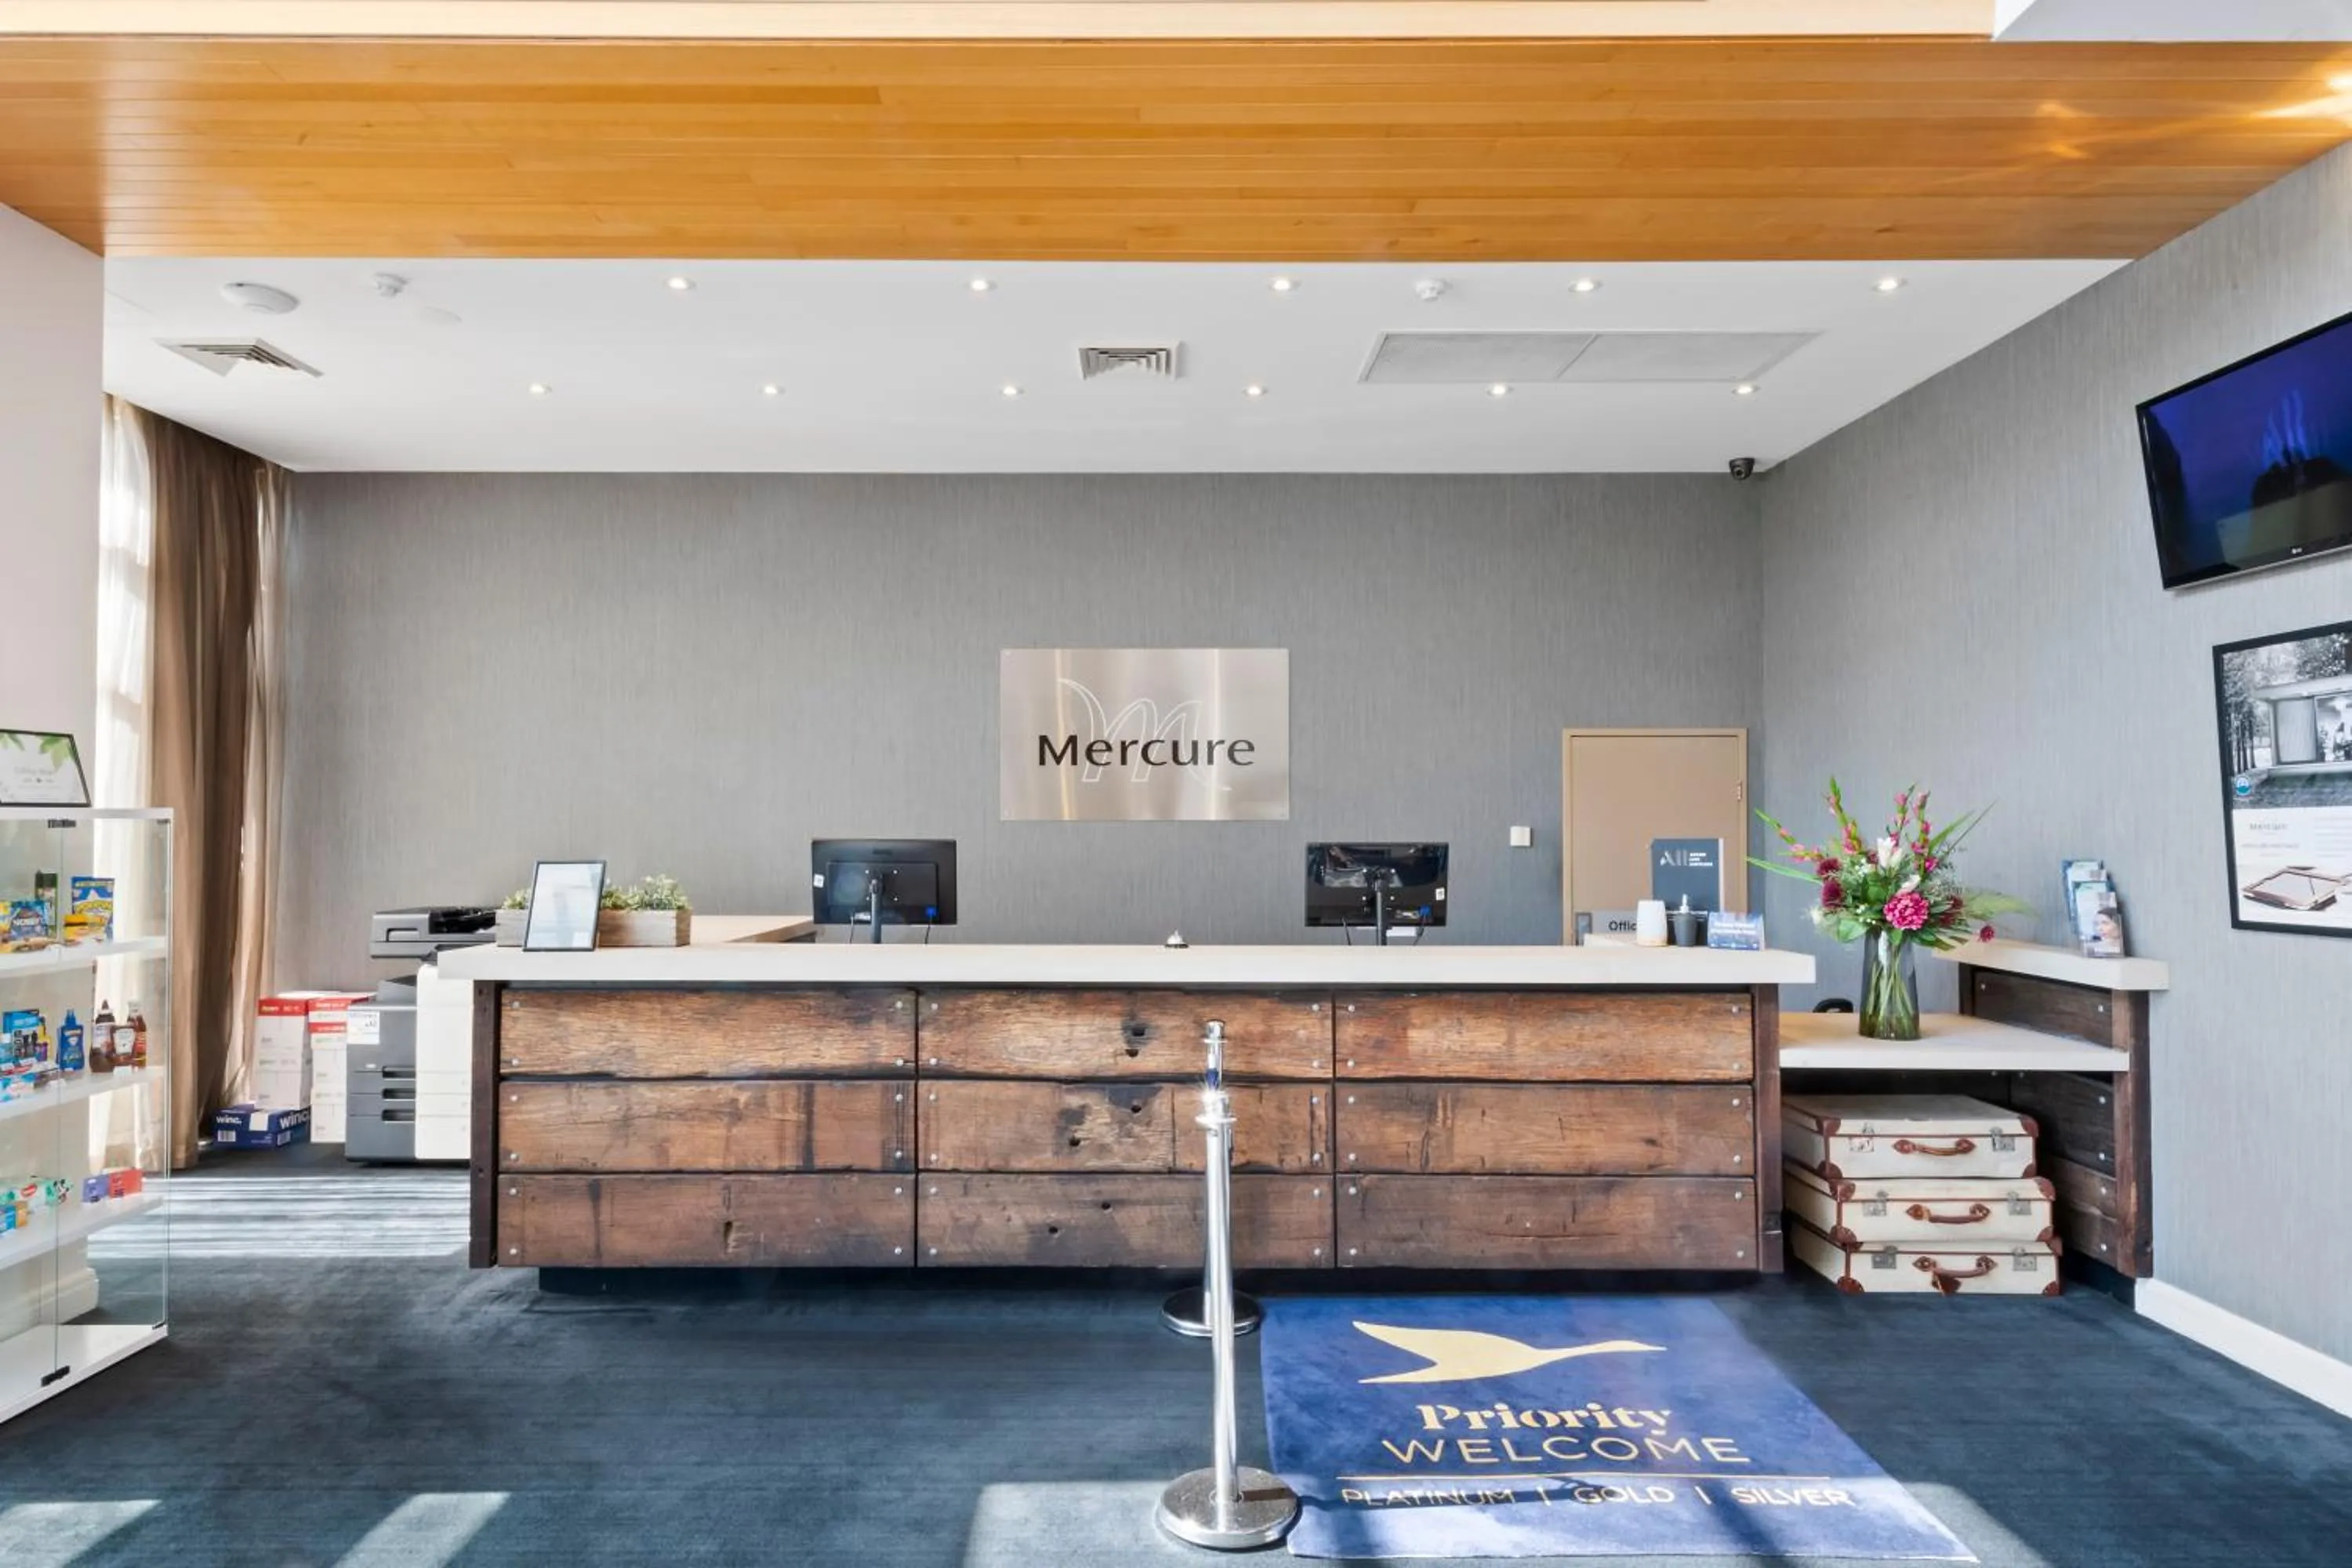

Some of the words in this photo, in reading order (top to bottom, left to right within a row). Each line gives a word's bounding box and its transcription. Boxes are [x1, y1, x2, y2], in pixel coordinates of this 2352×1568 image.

[1038, 734, 1255, 767] Mercure
[1608, 920, 1637, 931] Offic
[1416, 1403, 1671, 1436] Priority
[1381, 1436, 1751, 1464] WELCOME
[1341, 1489, 1516, 1506] PLATINUM
[1573, 1486, 1675, 1504] GOLD
[1730, 1486, 1857, 1507] SILVER
